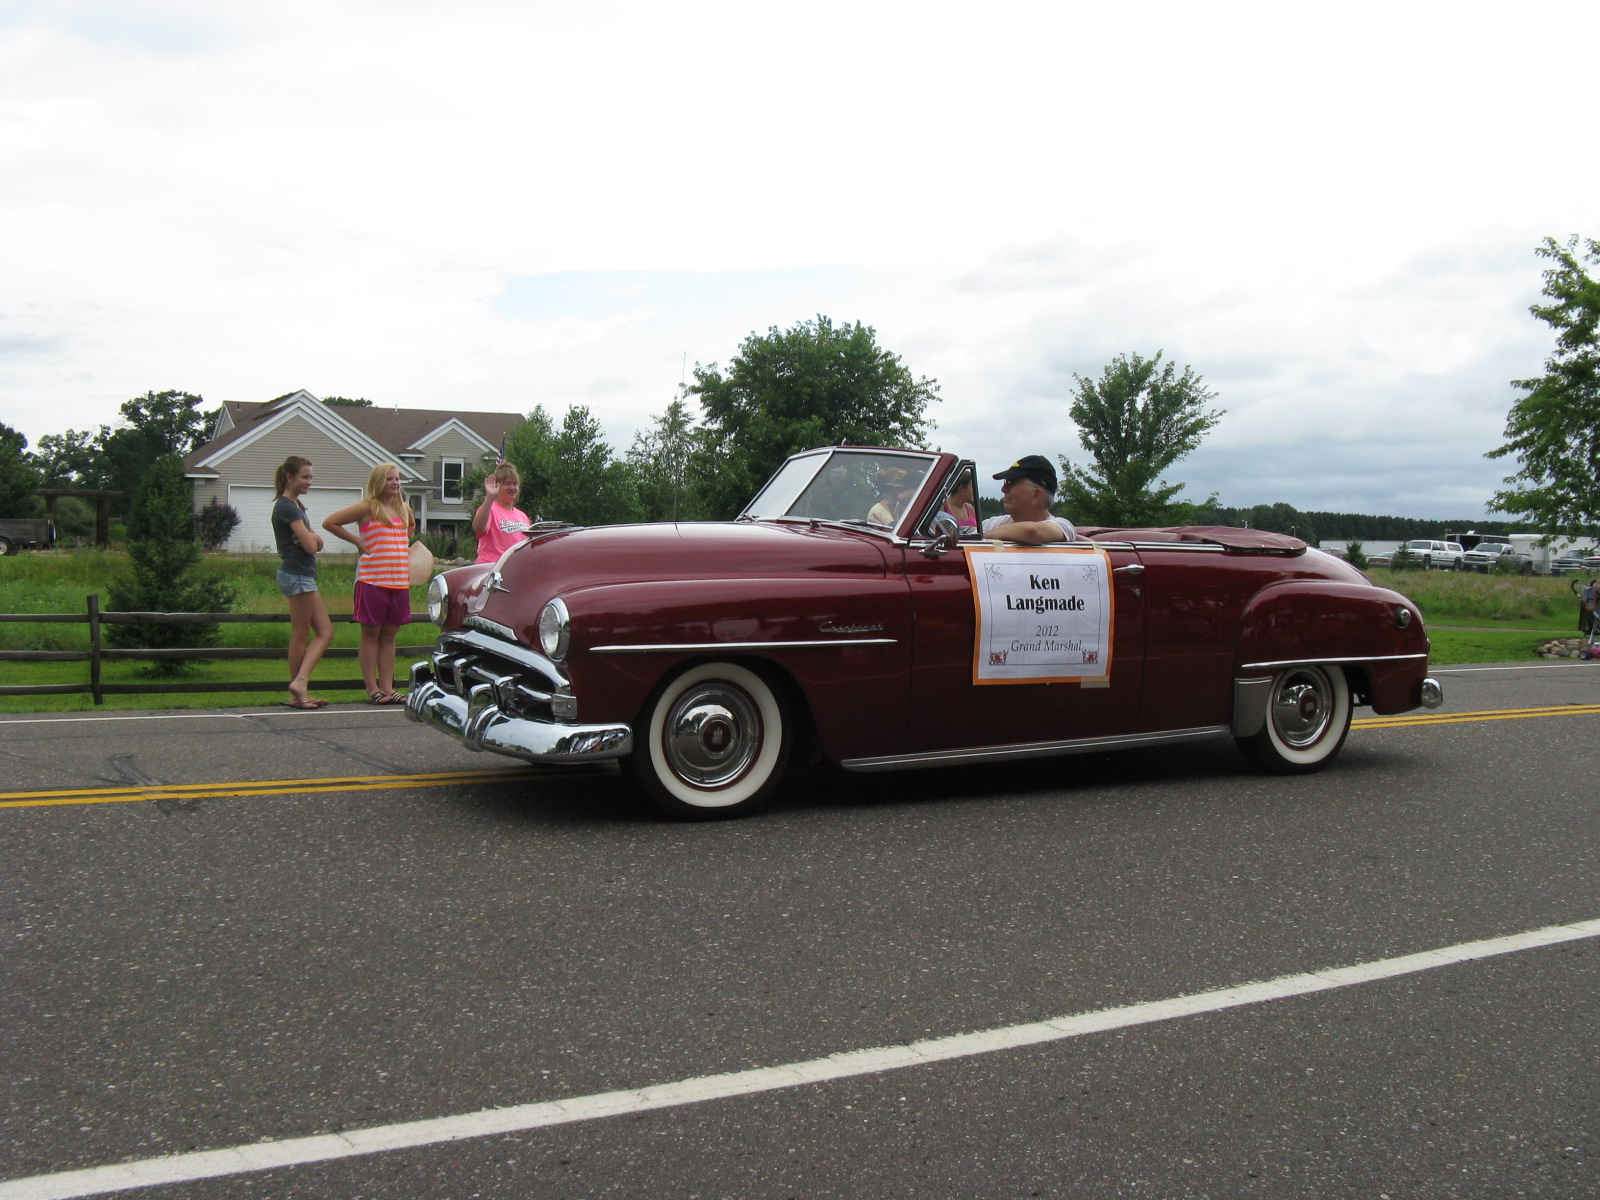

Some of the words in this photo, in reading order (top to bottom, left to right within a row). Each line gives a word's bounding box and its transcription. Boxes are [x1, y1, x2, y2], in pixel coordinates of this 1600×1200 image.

[1029, 574, 1060, 590] Ken
[1006, 594, 1085, 614] Langmade
[1035, 625, 1059, 637] 2012
[1011, 640, 1041, 652] Grand
[1043, 640, 1082, 652] Marshal
